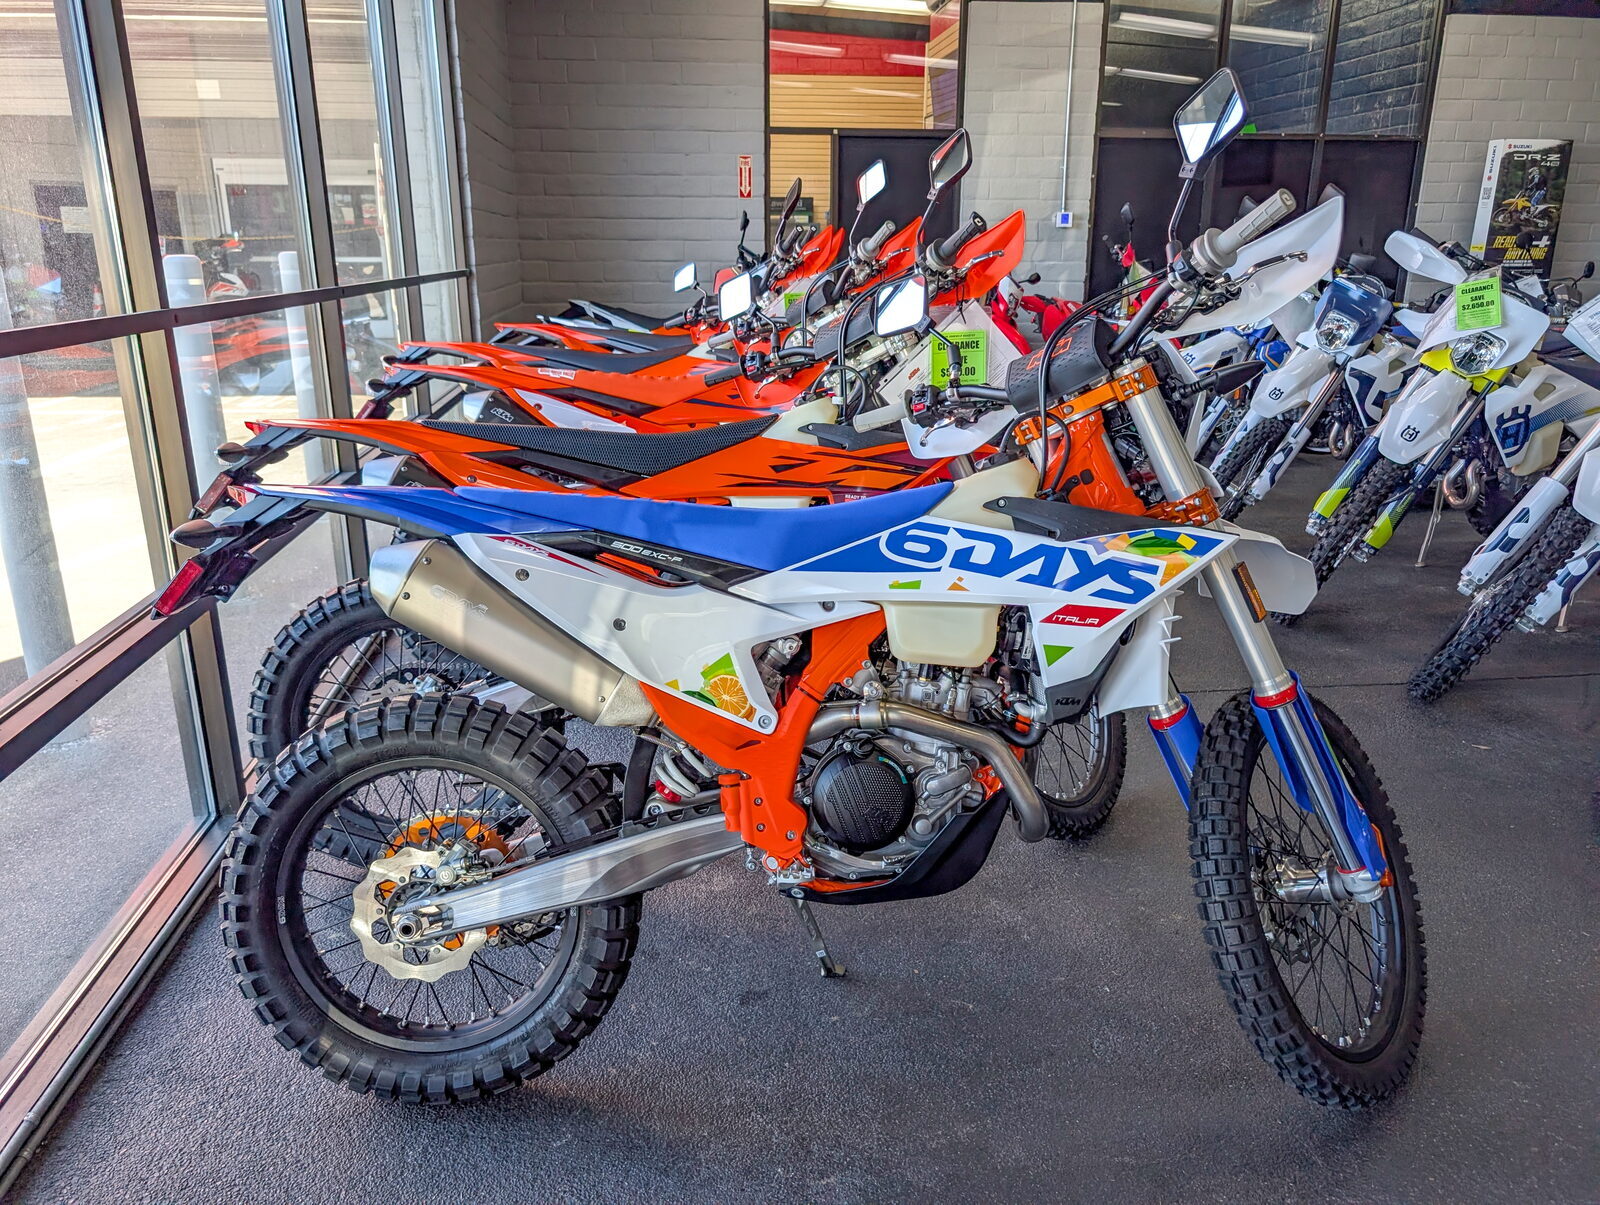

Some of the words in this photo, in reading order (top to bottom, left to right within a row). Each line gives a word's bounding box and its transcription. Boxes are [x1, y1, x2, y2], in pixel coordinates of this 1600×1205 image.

[1489, 145, 1497, 173] SUZUKI
[1493, 235, 1518, 248] READ
[1461, 284, 1494, 295] CLEARANCE
[1470, 294, 1485, 302] SAVE
[610, 540, 644, 553] 500
[641, 549, 683, 562] EXC-F
[885, 521, 1160, 605] 6DAYS
[1052, 614, 1100, 625] ITALIA
[1054, 697, 1081, 706] KTM
